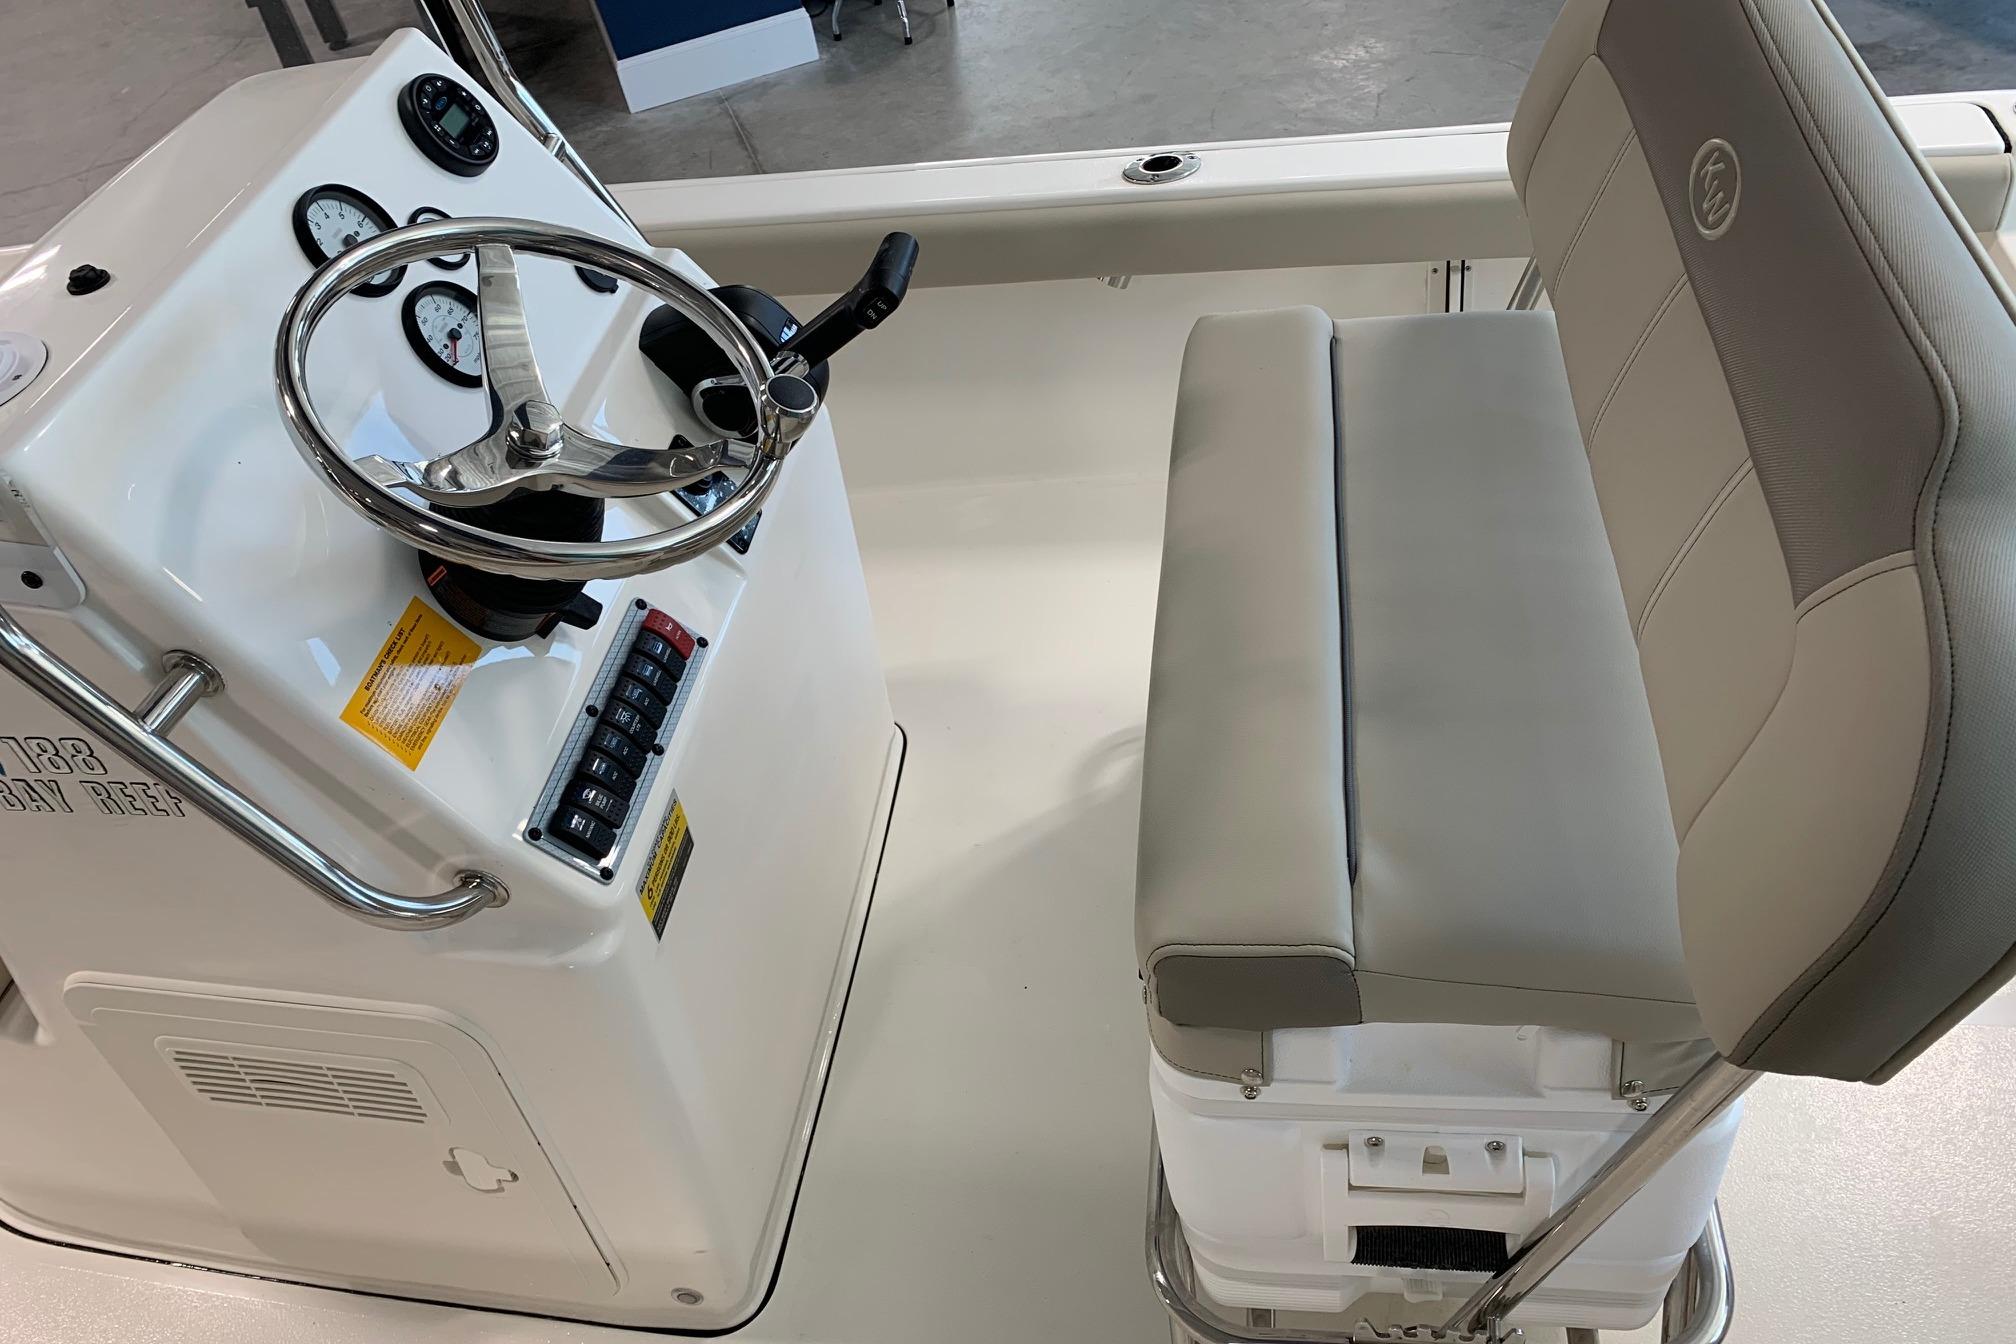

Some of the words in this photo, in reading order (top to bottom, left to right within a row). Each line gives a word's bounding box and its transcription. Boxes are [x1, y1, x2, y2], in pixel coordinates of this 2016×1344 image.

[866, 308, 878, 320] DN
[876, 300, 888, 310] UP
[383, 639, 398, 660] CHECK
[394, 626, 406, 641] LIST
[0, 736, 108, 776] 188
